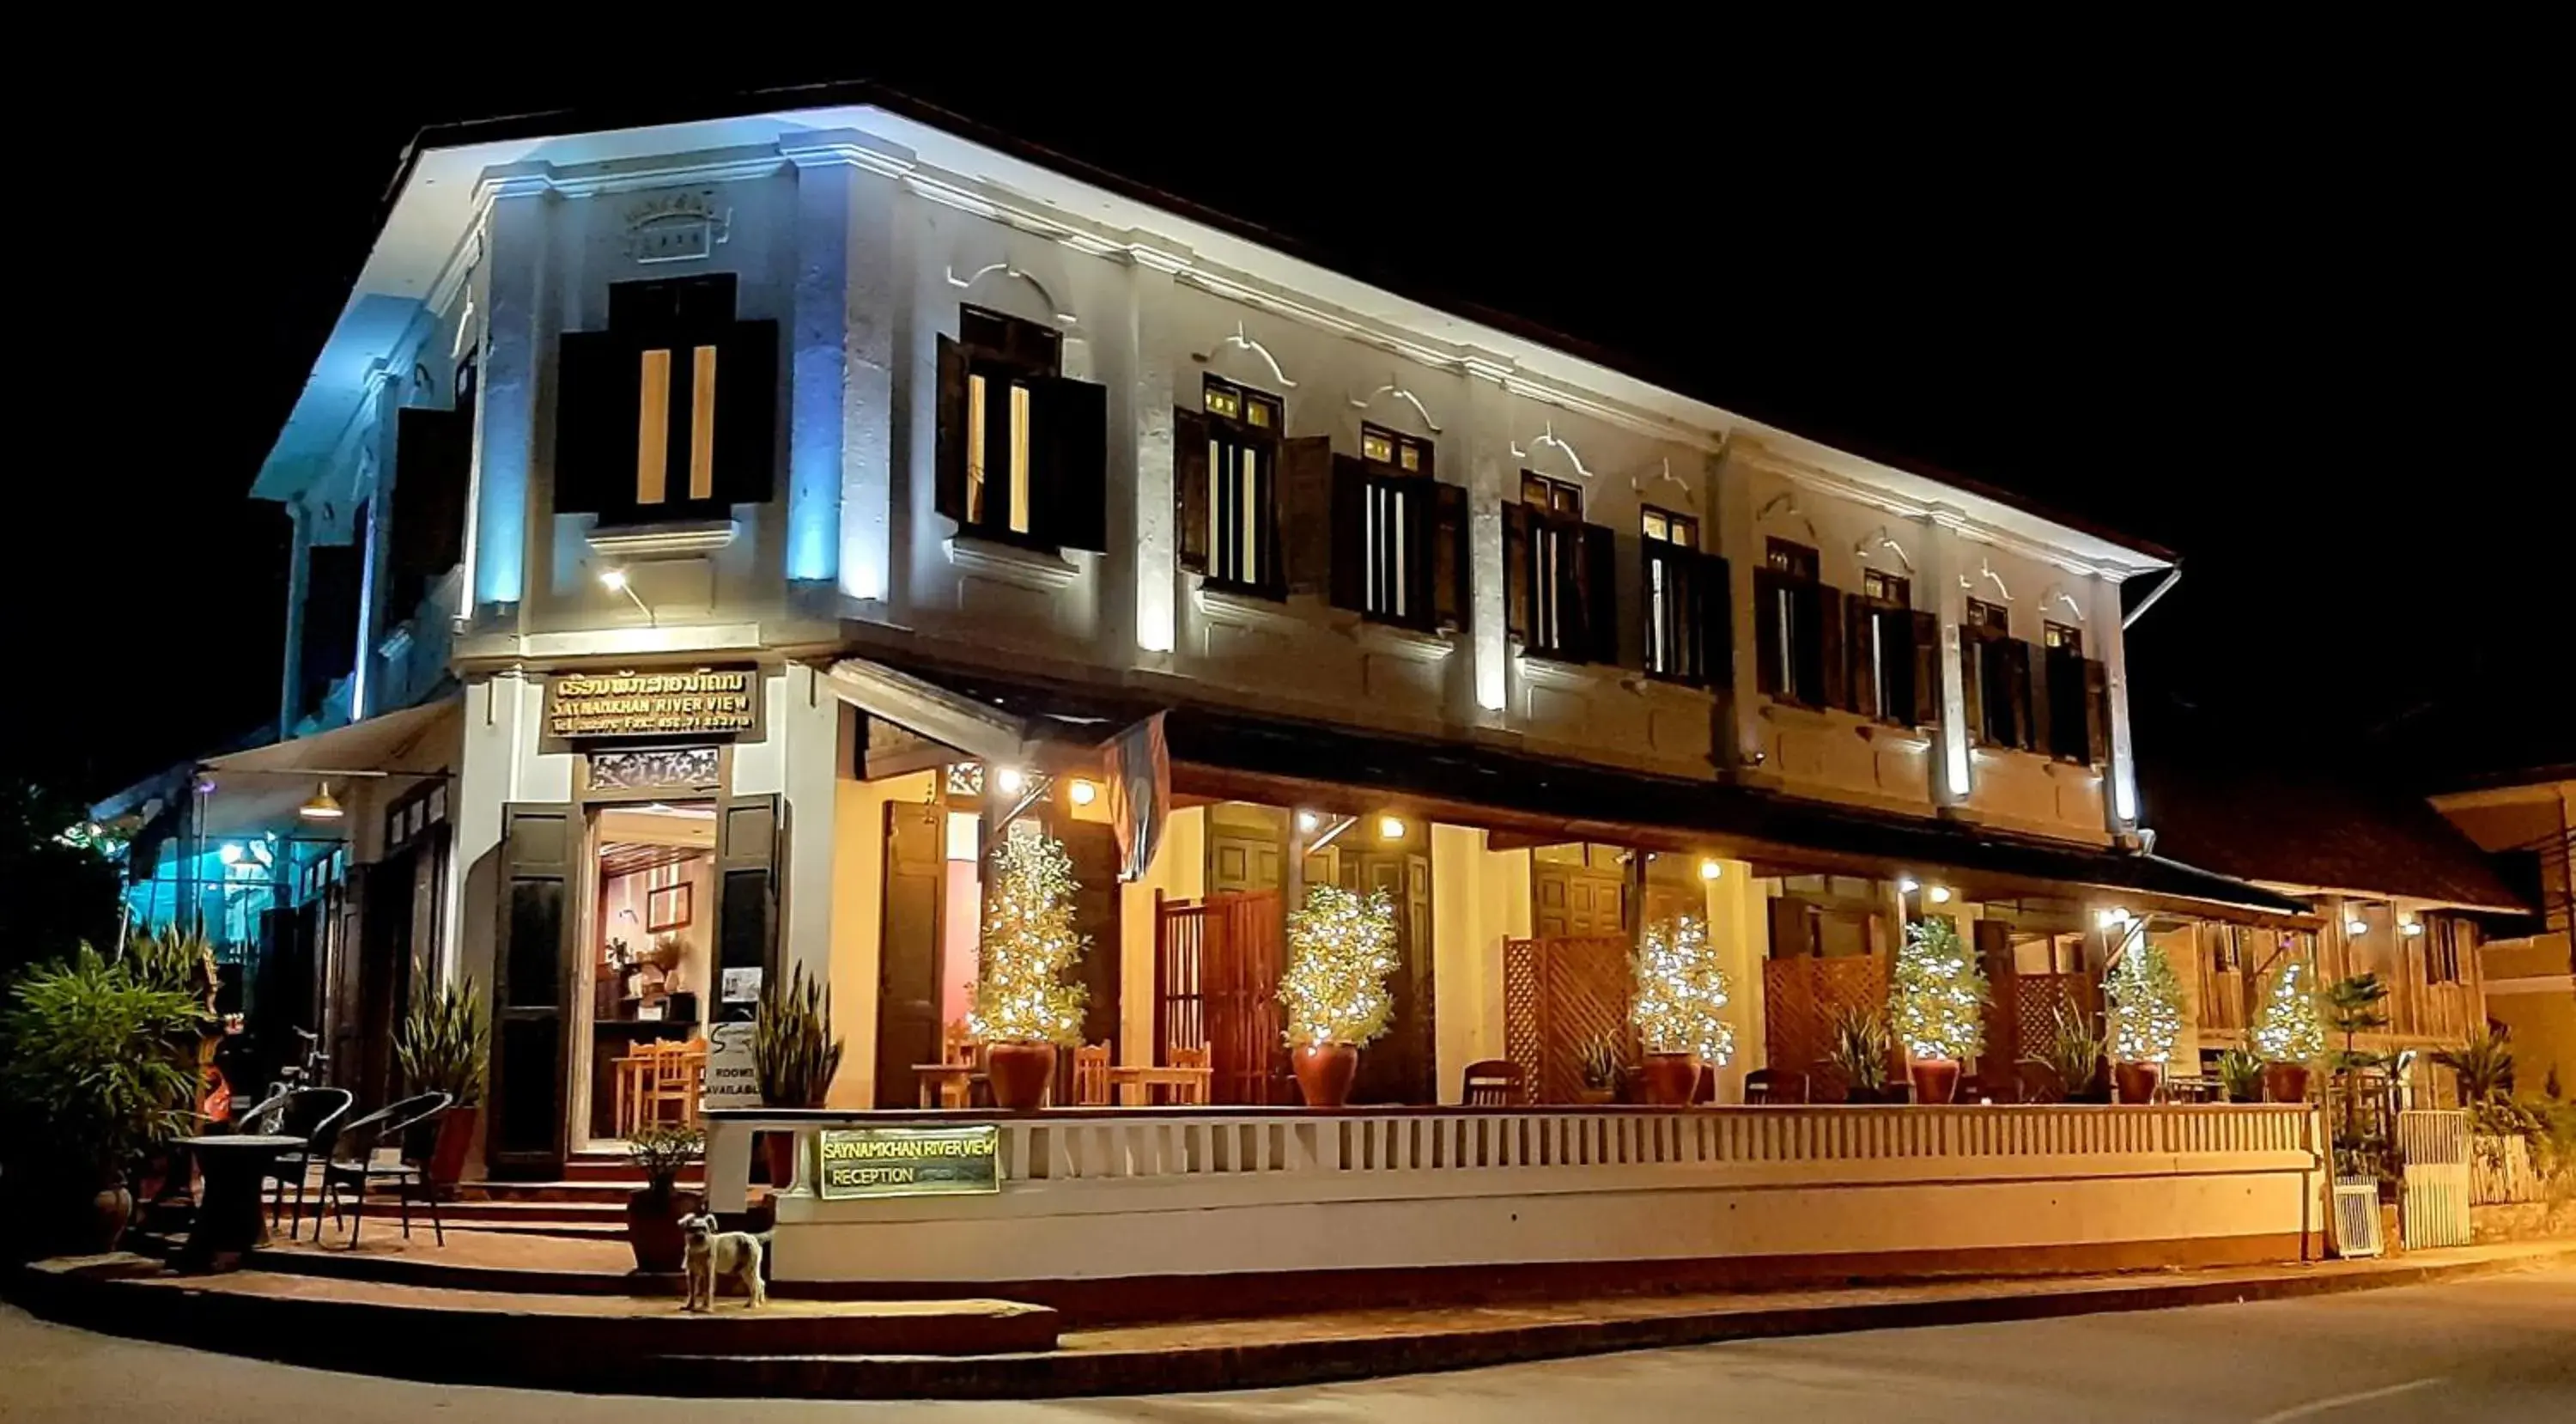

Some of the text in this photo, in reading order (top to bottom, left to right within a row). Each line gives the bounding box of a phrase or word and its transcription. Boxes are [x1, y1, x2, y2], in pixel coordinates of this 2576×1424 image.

[655, 697, 702, 712] RIVER
[707, 695, 747, 711] VIEW
[715, 1068, 754, 1078] ROOMS
[706, 1085, 759, 1095] AVAILABL
[823, 1138, 995, 1159] SAYNAMKHAN RIVER VIEW
[831, 1166, 914, 1186] RECEPTION
